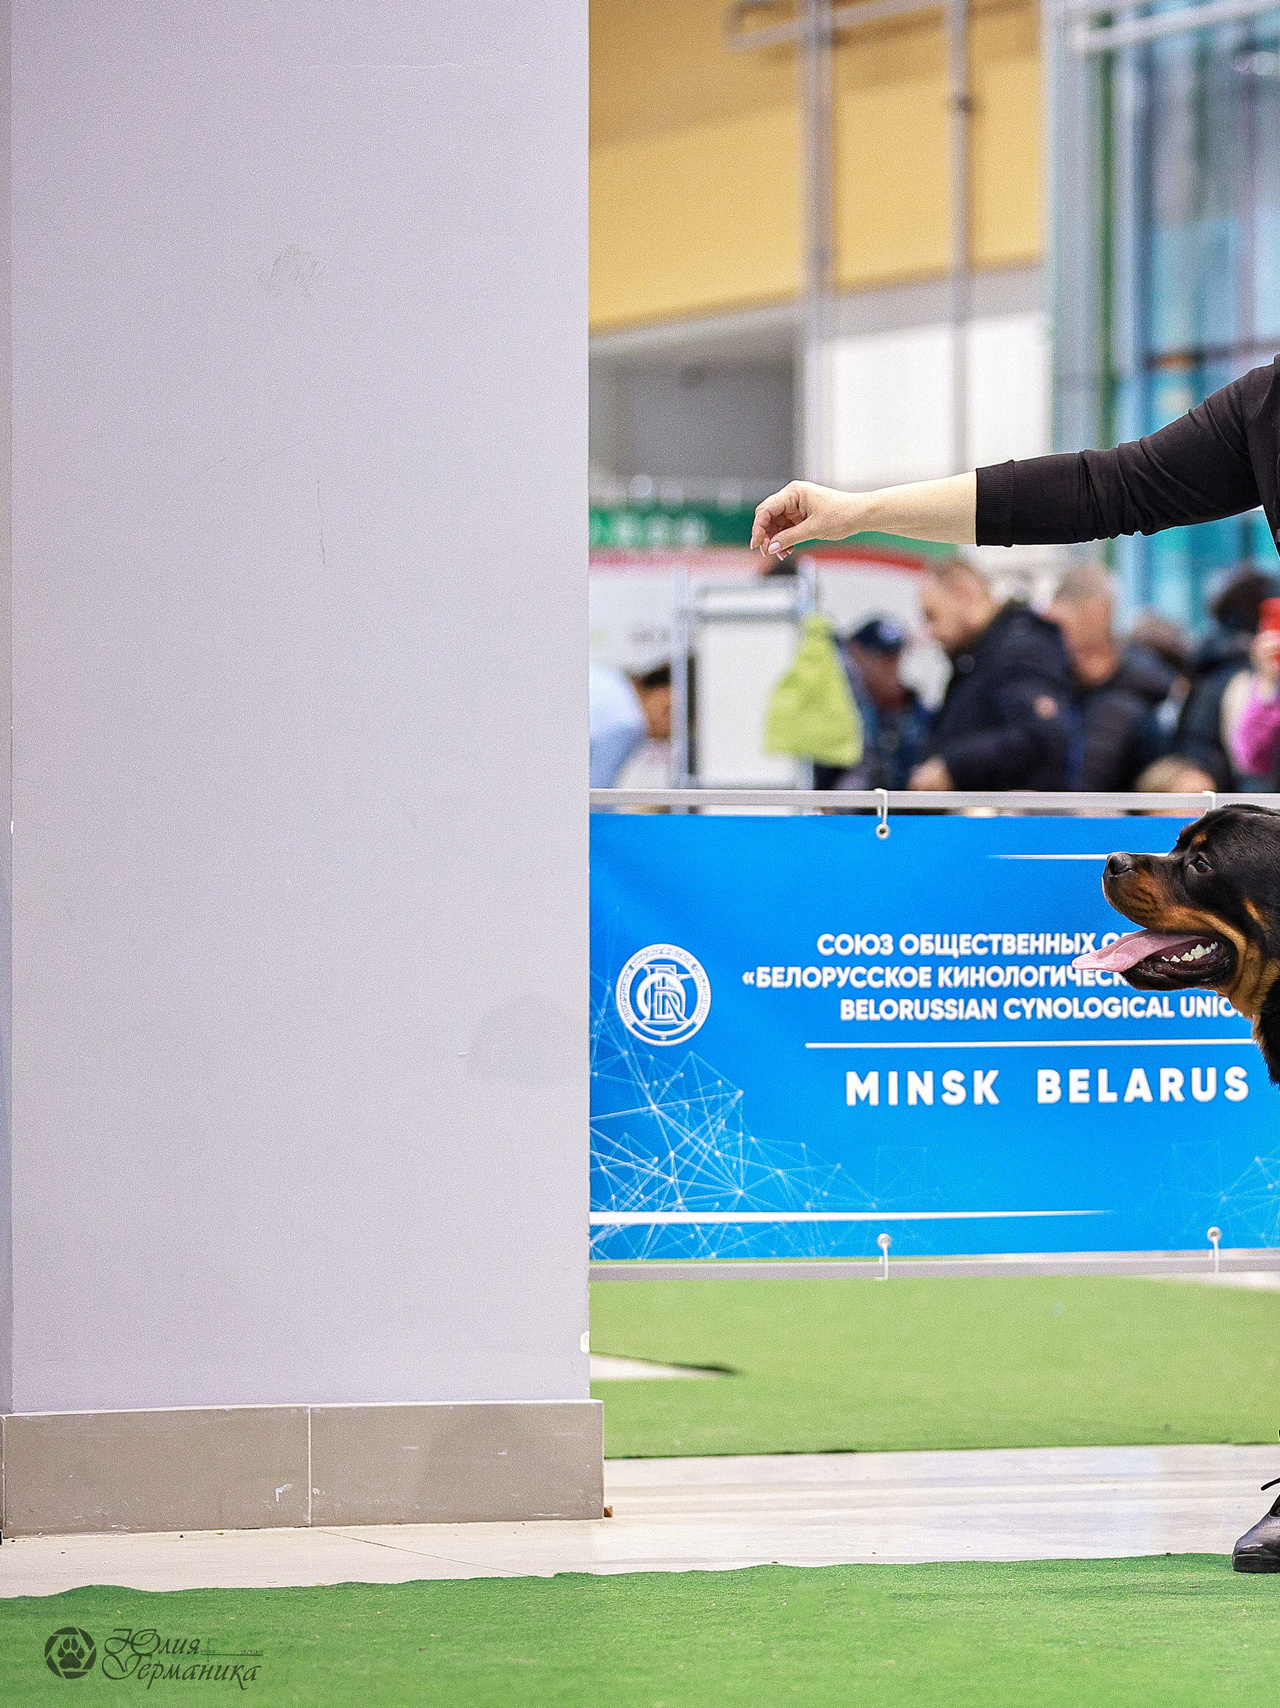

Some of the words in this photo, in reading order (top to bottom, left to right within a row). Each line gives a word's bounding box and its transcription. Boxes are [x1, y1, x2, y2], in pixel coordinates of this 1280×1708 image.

[817, 933, 895, 957] СОЮЗ
[899, 931, 1097, 959] ОБЩЕСТВЕННЫХ
[742, 965, 933, 989] «БЕЛОРУССКОЕ
[937, 964, 1130, 988] КИНОЛОГИЧЕСК
[840, 998, 998, 1021] BELORUSSIAN
[1003, 996, 1176, 1020] CYNOLOGICAL
[1180, 995, 1243, 1018] UNIO
[846, 1069, 1001, 1106] MINSK
[1036, 1066, 1250, 1104] BELARUS
